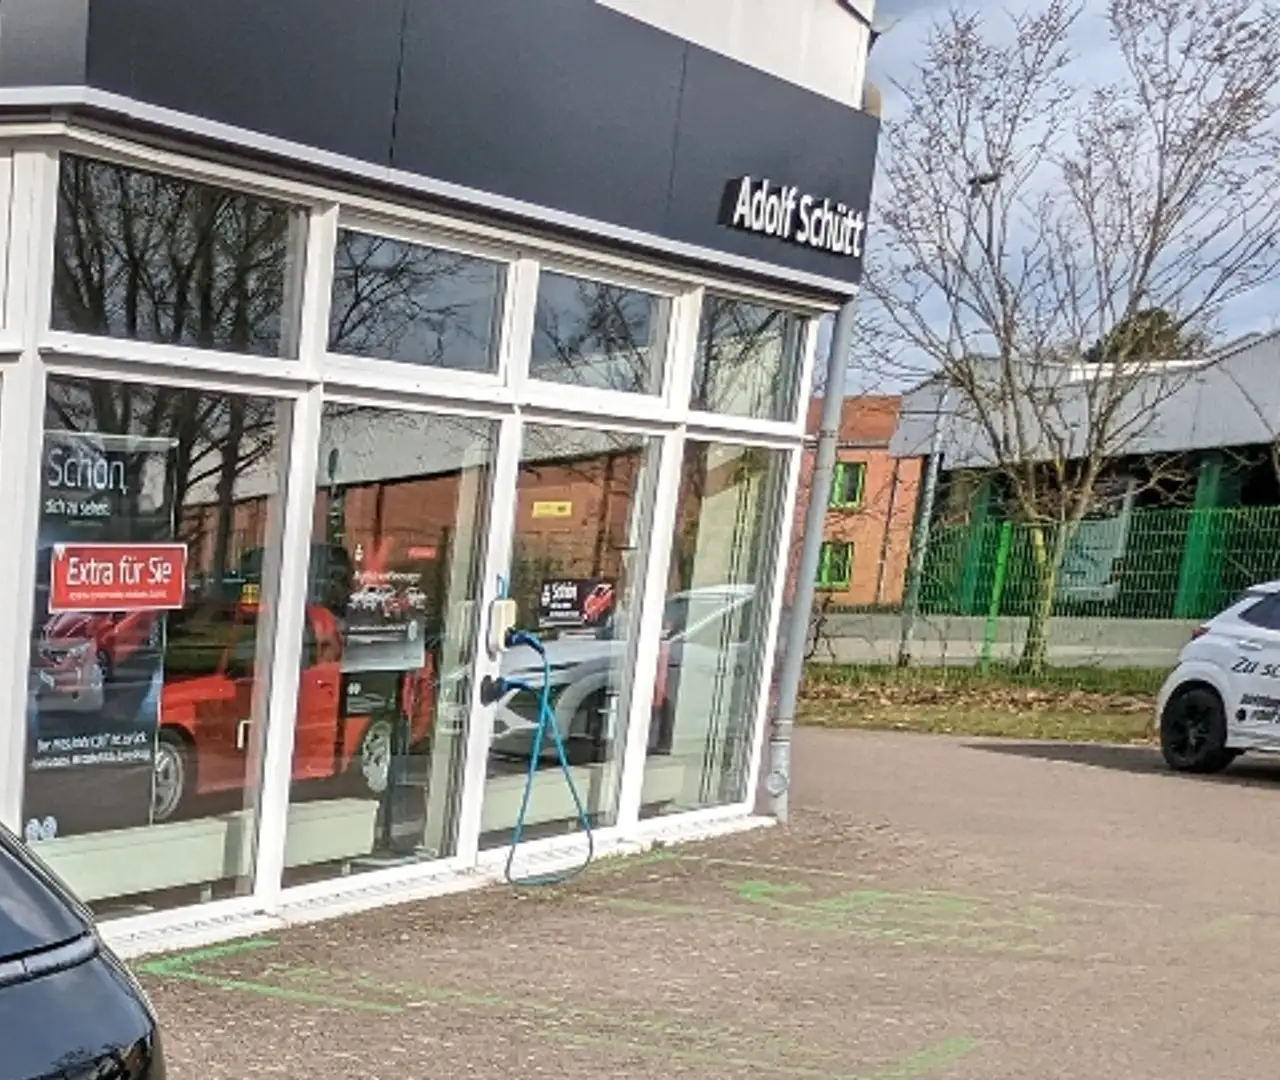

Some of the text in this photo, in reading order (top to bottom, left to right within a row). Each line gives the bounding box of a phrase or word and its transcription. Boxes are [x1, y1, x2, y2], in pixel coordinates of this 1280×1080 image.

[733, 176, 864, 257] Adolf Schütt
[66, 555, 173, 586] Extra für Sie
